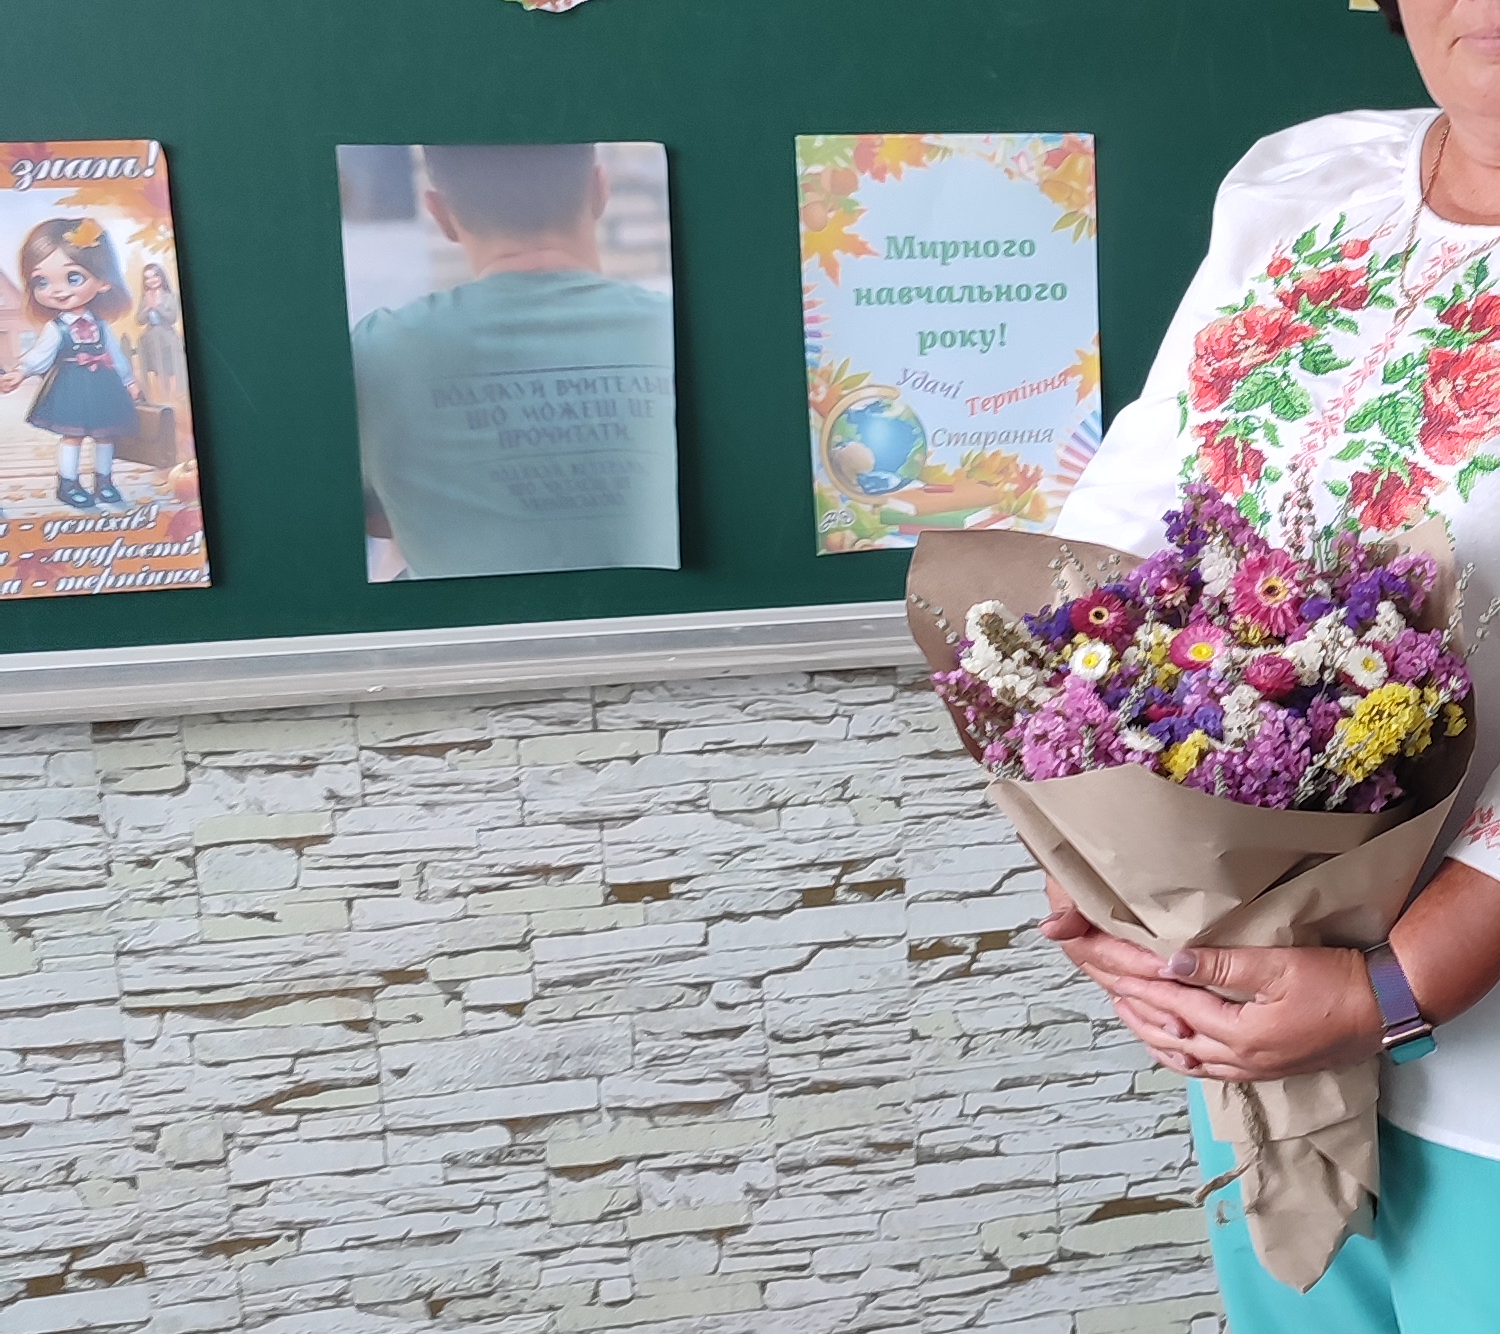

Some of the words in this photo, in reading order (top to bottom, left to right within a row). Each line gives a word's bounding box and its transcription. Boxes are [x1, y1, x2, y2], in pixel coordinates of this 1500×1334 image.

[11, 140, 160, 191] знань!
[884, 234, 1037, 266] Мирного
[853, 281, 1068, 307] навчального
[917, 323, 1008, 356] року!
[896, 366, 964, 400] Удачі
[965, 370, 1073, 418] Терпіння
[931, 425, 1054, 450] Старання
[42, 503, 160, 542] успіхів!
[40, 530, 204, 568] мудрості!
[55, 561, 210, 595] терпіння!
